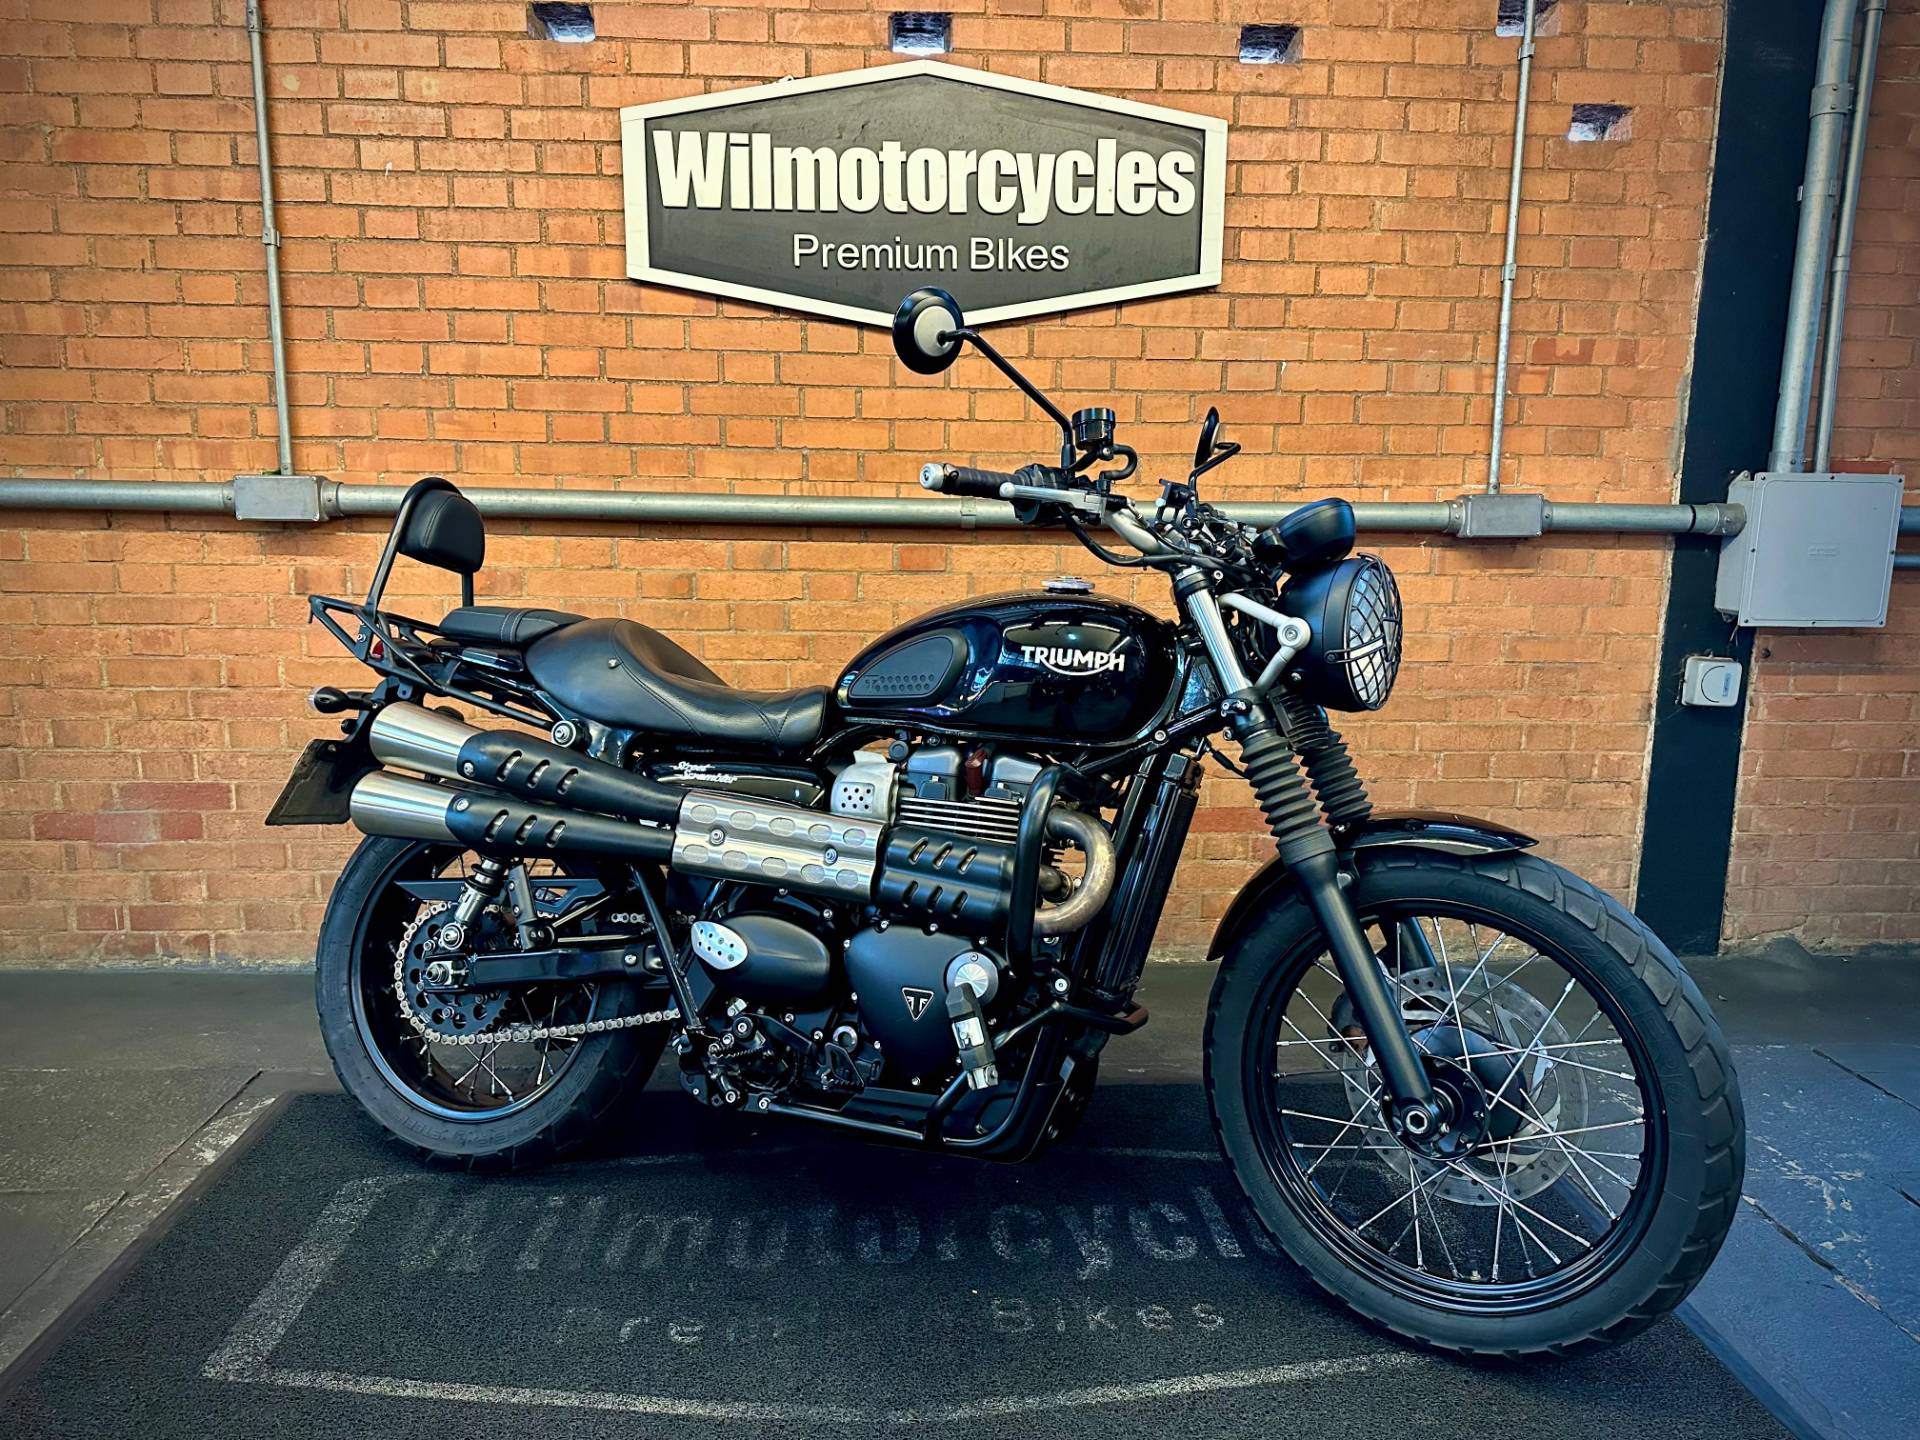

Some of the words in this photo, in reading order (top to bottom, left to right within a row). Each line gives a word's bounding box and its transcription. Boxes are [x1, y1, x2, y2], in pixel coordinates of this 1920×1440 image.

[653, 130, 1196, 224] Wilmotorcycles
[792, 233, 958, 270] Premium
[1021, 645, 1125, 674] TRIUMPH
